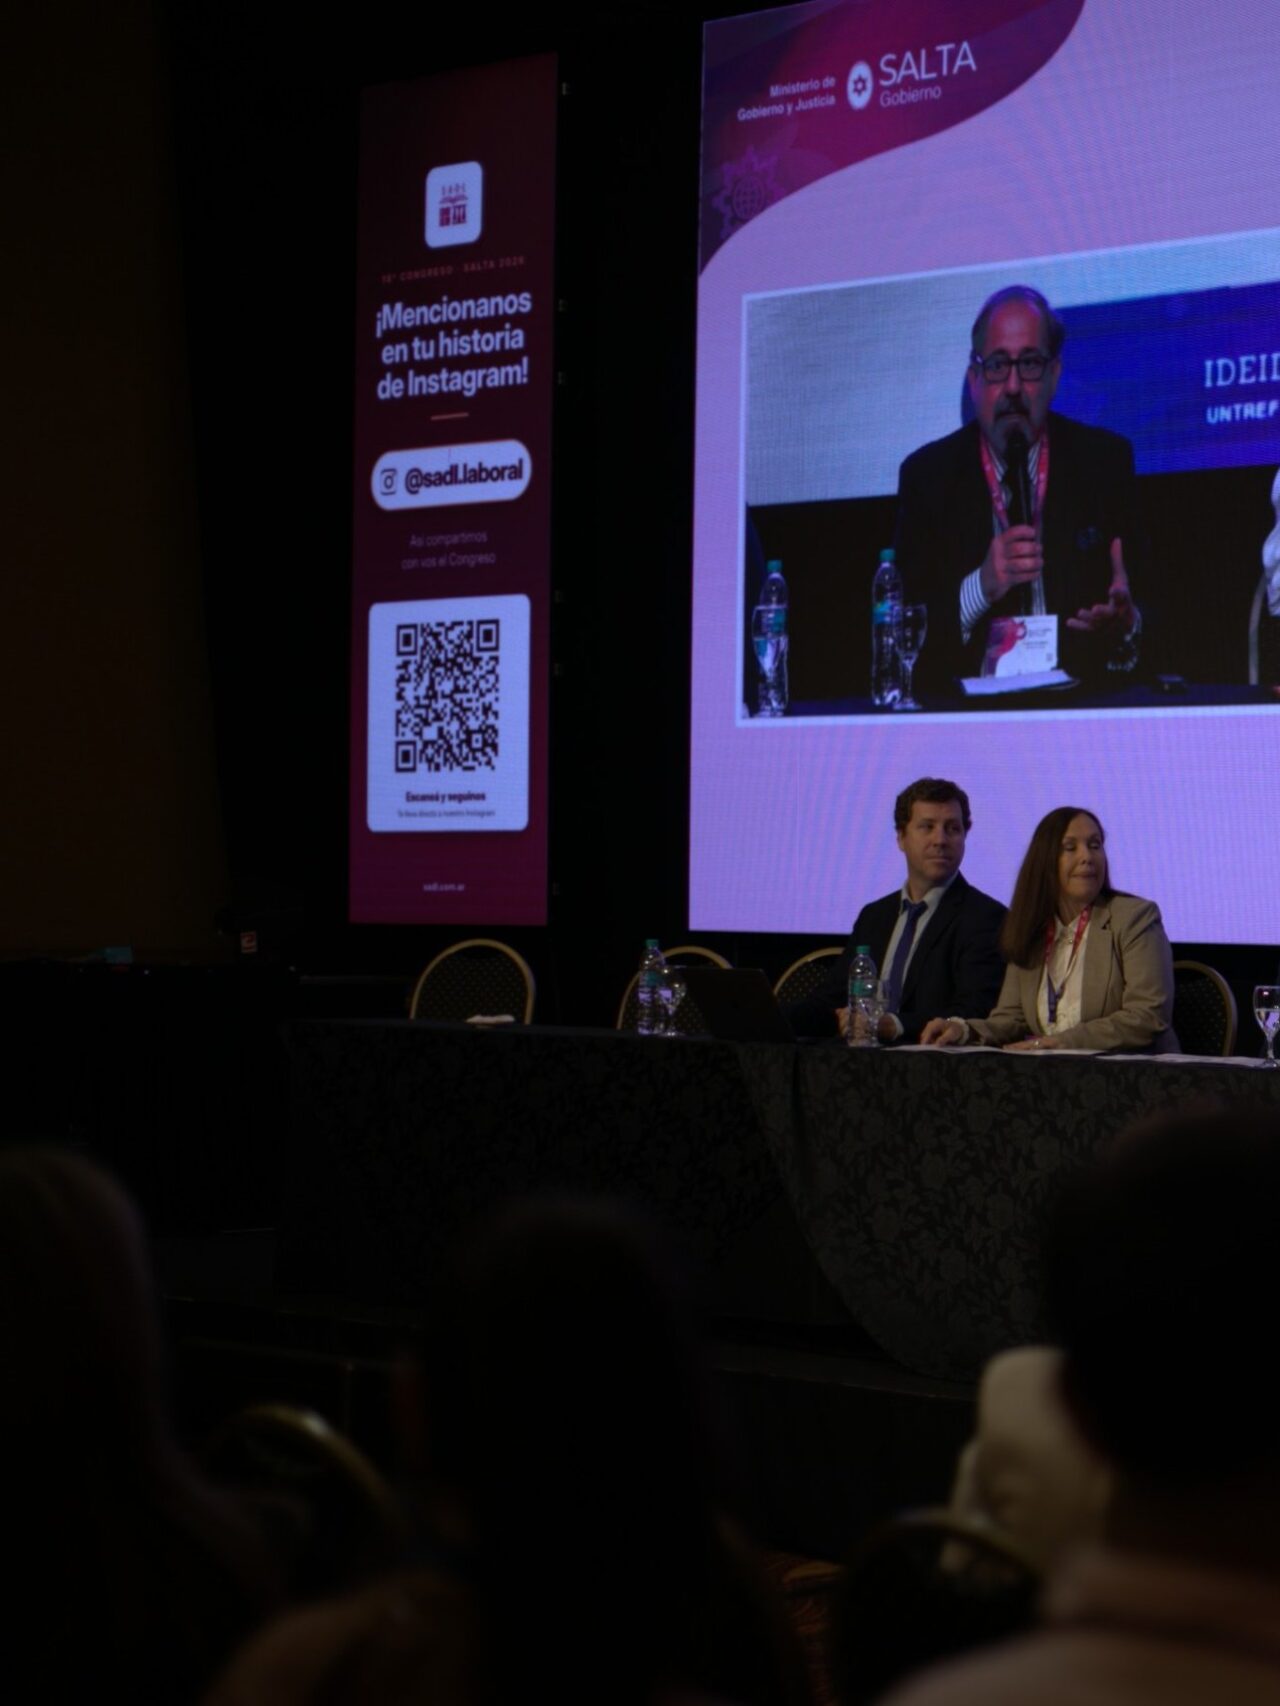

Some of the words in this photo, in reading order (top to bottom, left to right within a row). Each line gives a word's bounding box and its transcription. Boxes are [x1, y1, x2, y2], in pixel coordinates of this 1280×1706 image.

[879, 40, 978, 87] SALTA
[769, 77, 821, 97] Ministerio
[822, 76, 836, 88] de
[879, 84, 942, 108] Gobierno
[737, 101, 785, 122] Gobierno
[786, 101, 793, 115] y
[795, 93, 836, 111] Justicia
[375, 291, 533, 339] ¡Mencionanos
[380, 341, 409, 365] en
[411, 335, 435, 361] tu
[438, 322, 525, 358] historia
[376, 371, 405, 400] de
[407, 355, 529, 398] Instagram!
[1206, 399, 1279, 425] UNTREF
[405, 458, 523, 494] @sadl.laboral
